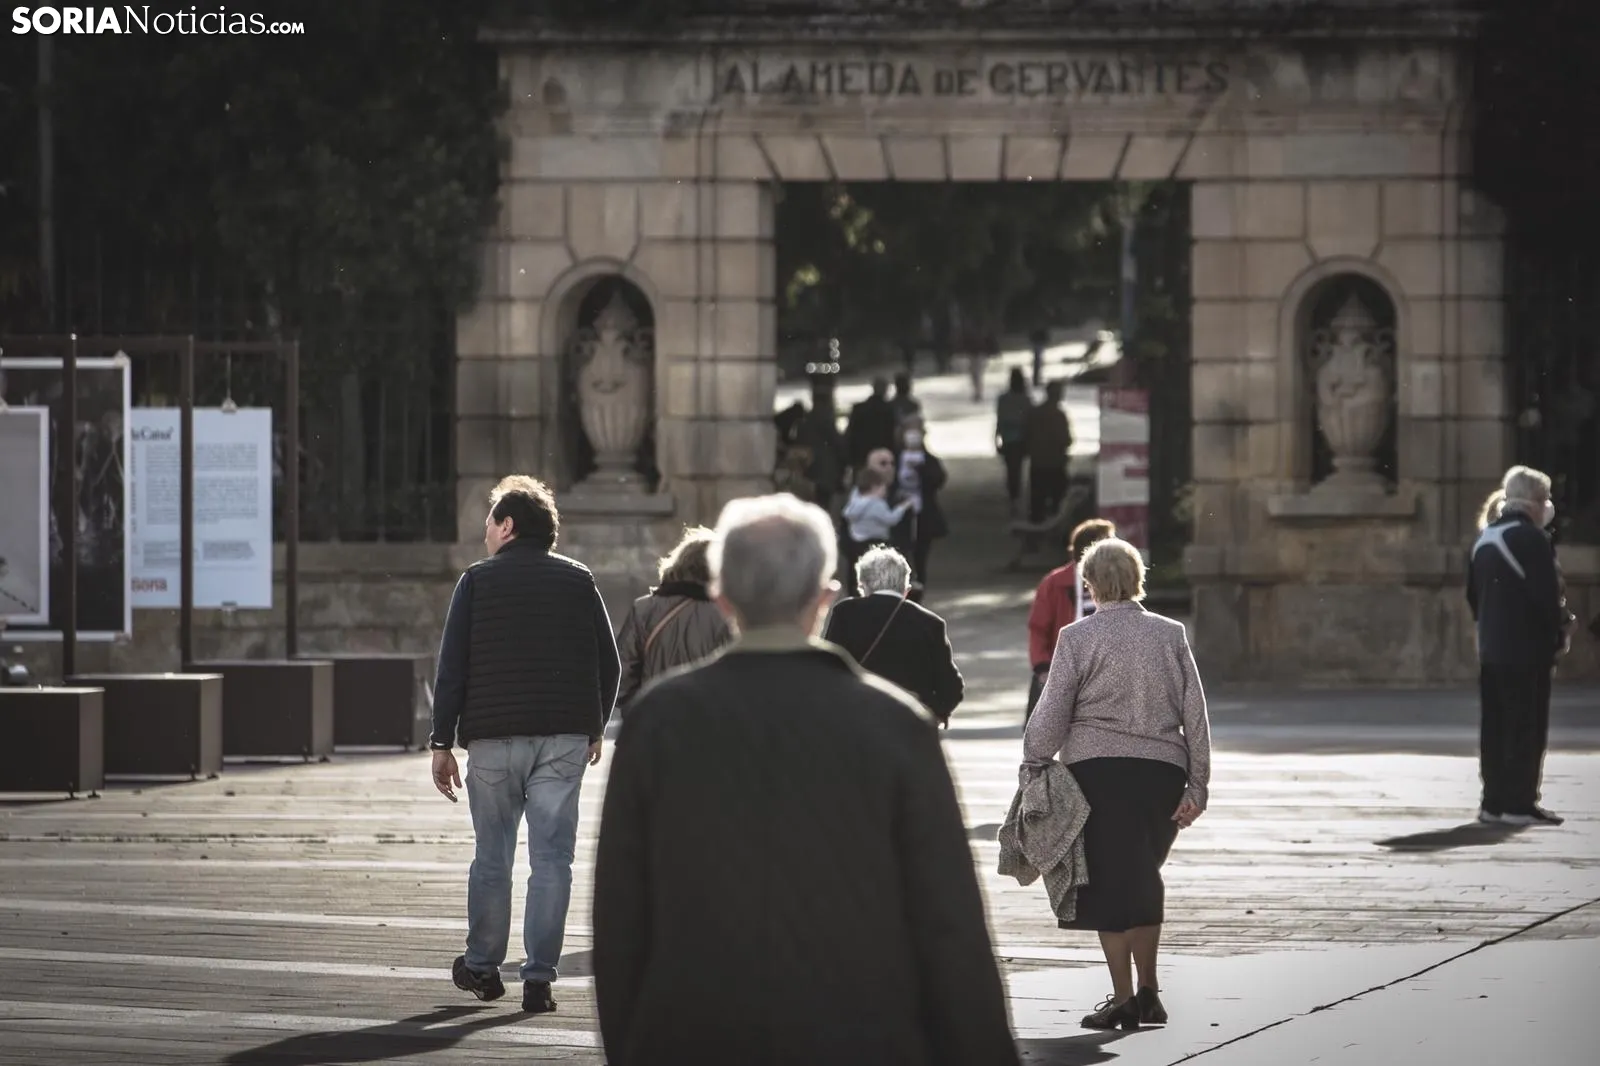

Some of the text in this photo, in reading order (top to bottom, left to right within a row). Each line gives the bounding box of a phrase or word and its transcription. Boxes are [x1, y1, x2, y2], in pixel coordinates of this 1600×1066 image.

[724, 61, 1229, 96] ALAMEDA DE CERVANTES
